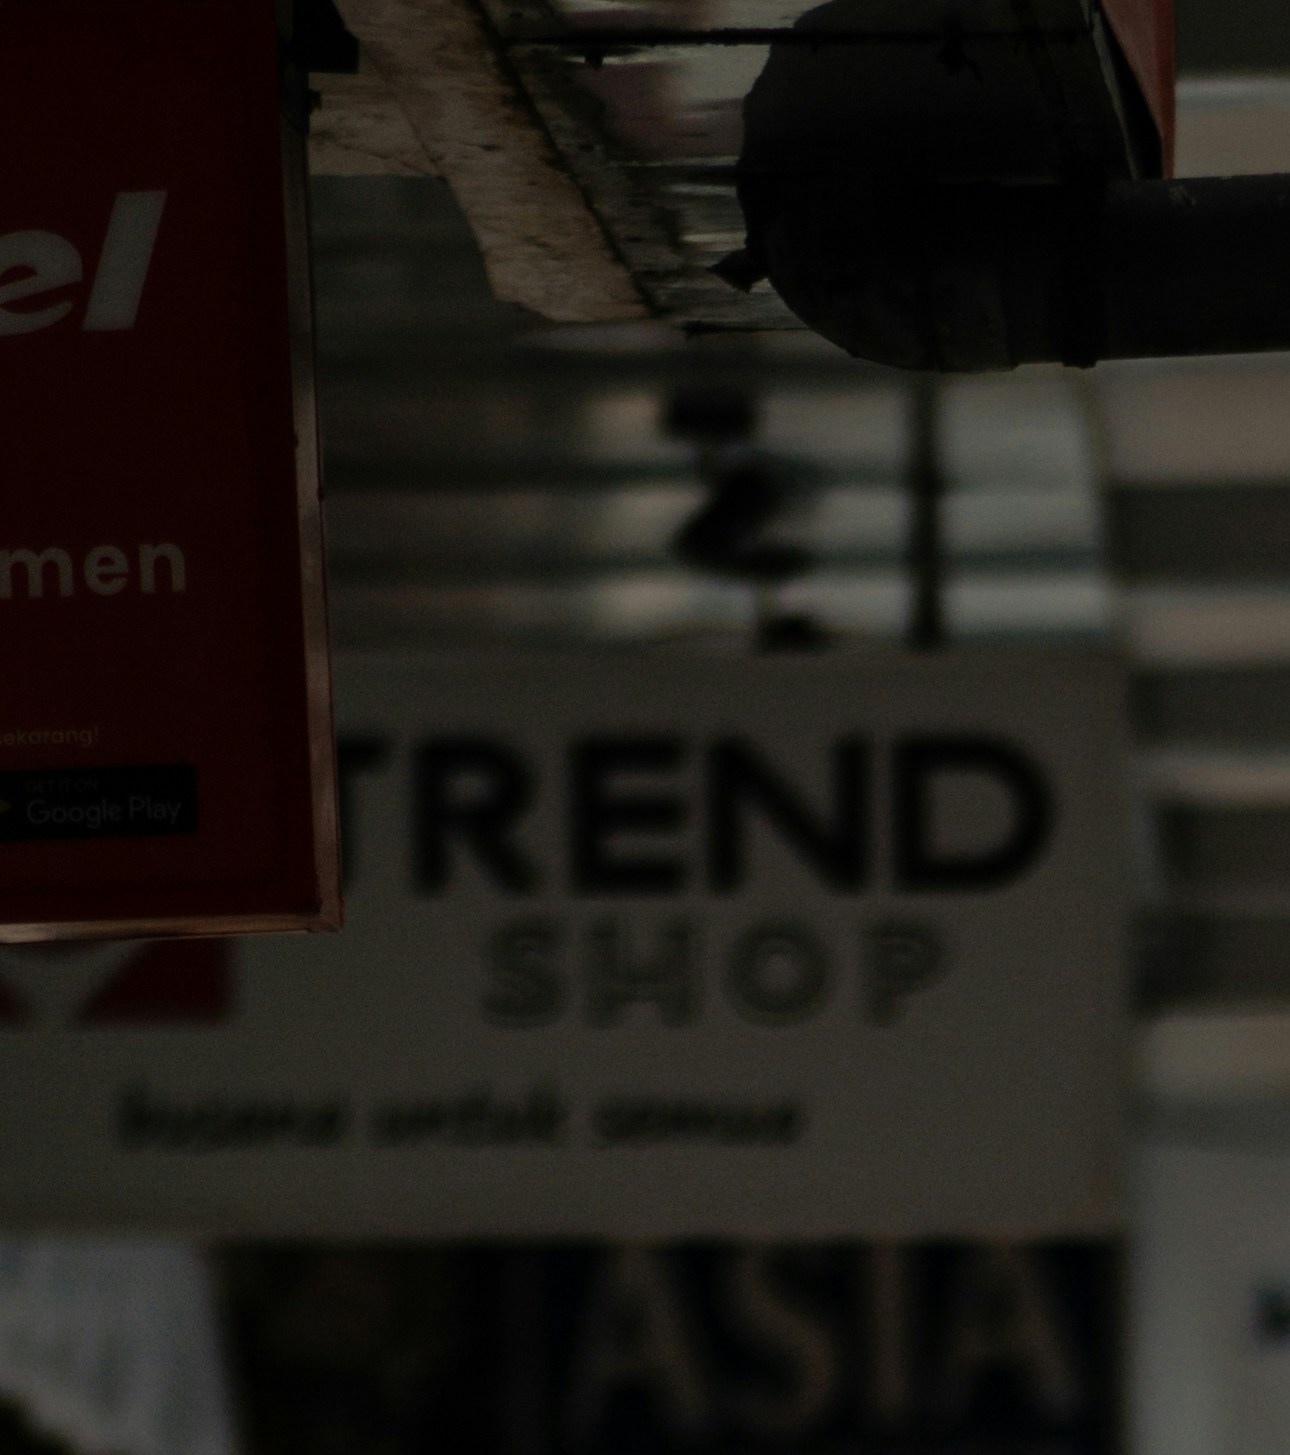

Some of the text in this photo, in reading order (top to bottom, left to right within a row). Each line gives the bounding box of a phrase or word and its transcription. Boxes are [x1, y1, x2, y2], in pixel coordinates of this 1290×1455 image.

[0, 727, 99, 747] ekarang!
[26, 795, 182, 829] Google Play
[490, 917, 942, 1020] SHOP
